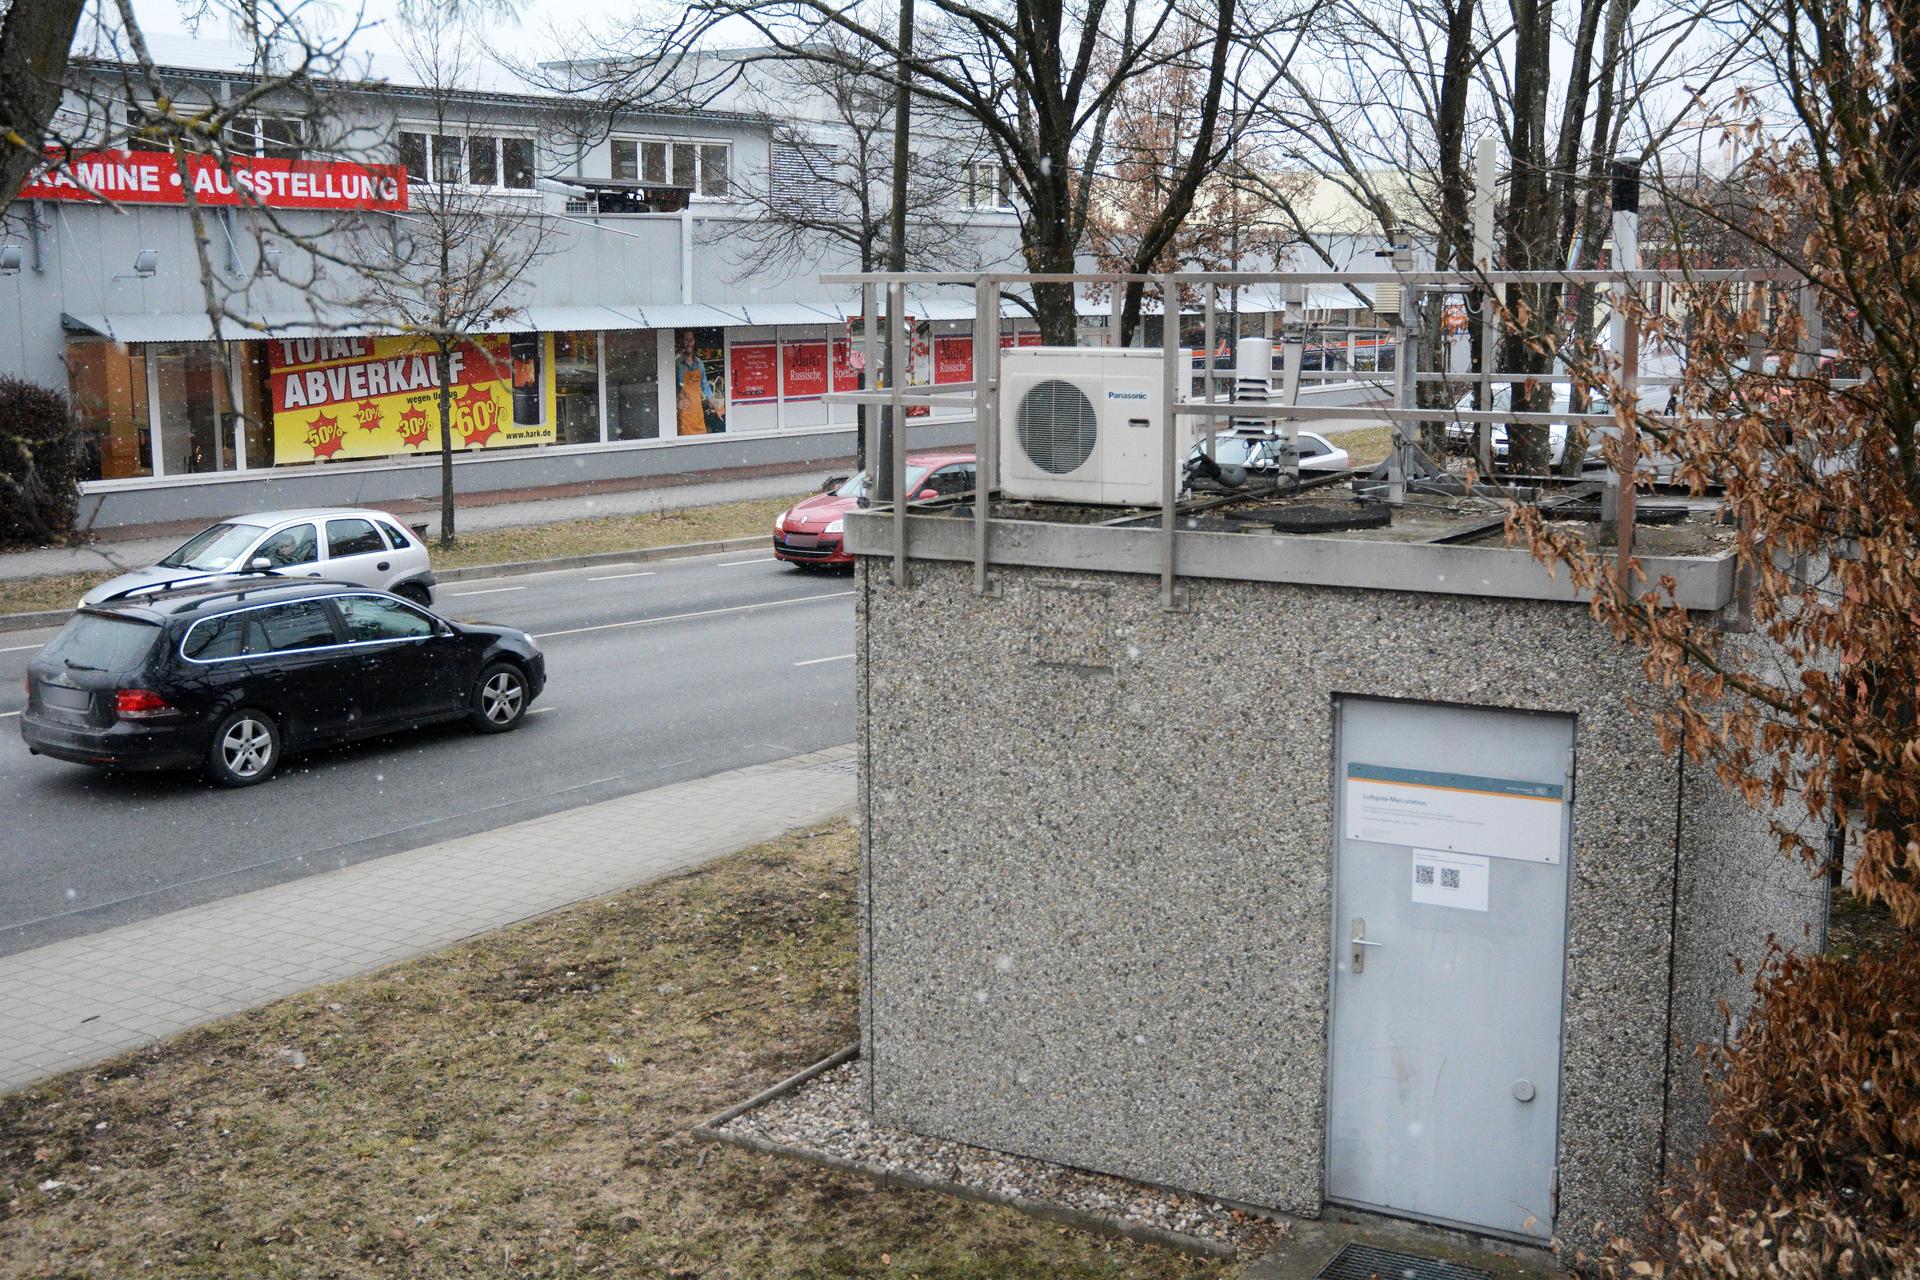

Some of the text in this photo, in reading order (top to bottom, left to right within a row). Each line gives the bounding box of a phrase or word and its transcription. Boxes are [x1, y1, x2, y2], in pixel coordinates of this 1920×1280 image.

[193, 167, 399, 201] AUSSTELLUNG
[284, 350, 465, 409] ABVERKAUF
[406, 394, 432, 405] wegen
[1108, 391, 1148, 400] Panasonic
[358, 407, 383, 424] 20%
[400, 415, 434, 438] 30%
[456, 396, 508, 437] 60%
[307, 422, 343, 448] 50%
[506, 429, 552, 440] www.hark.de
